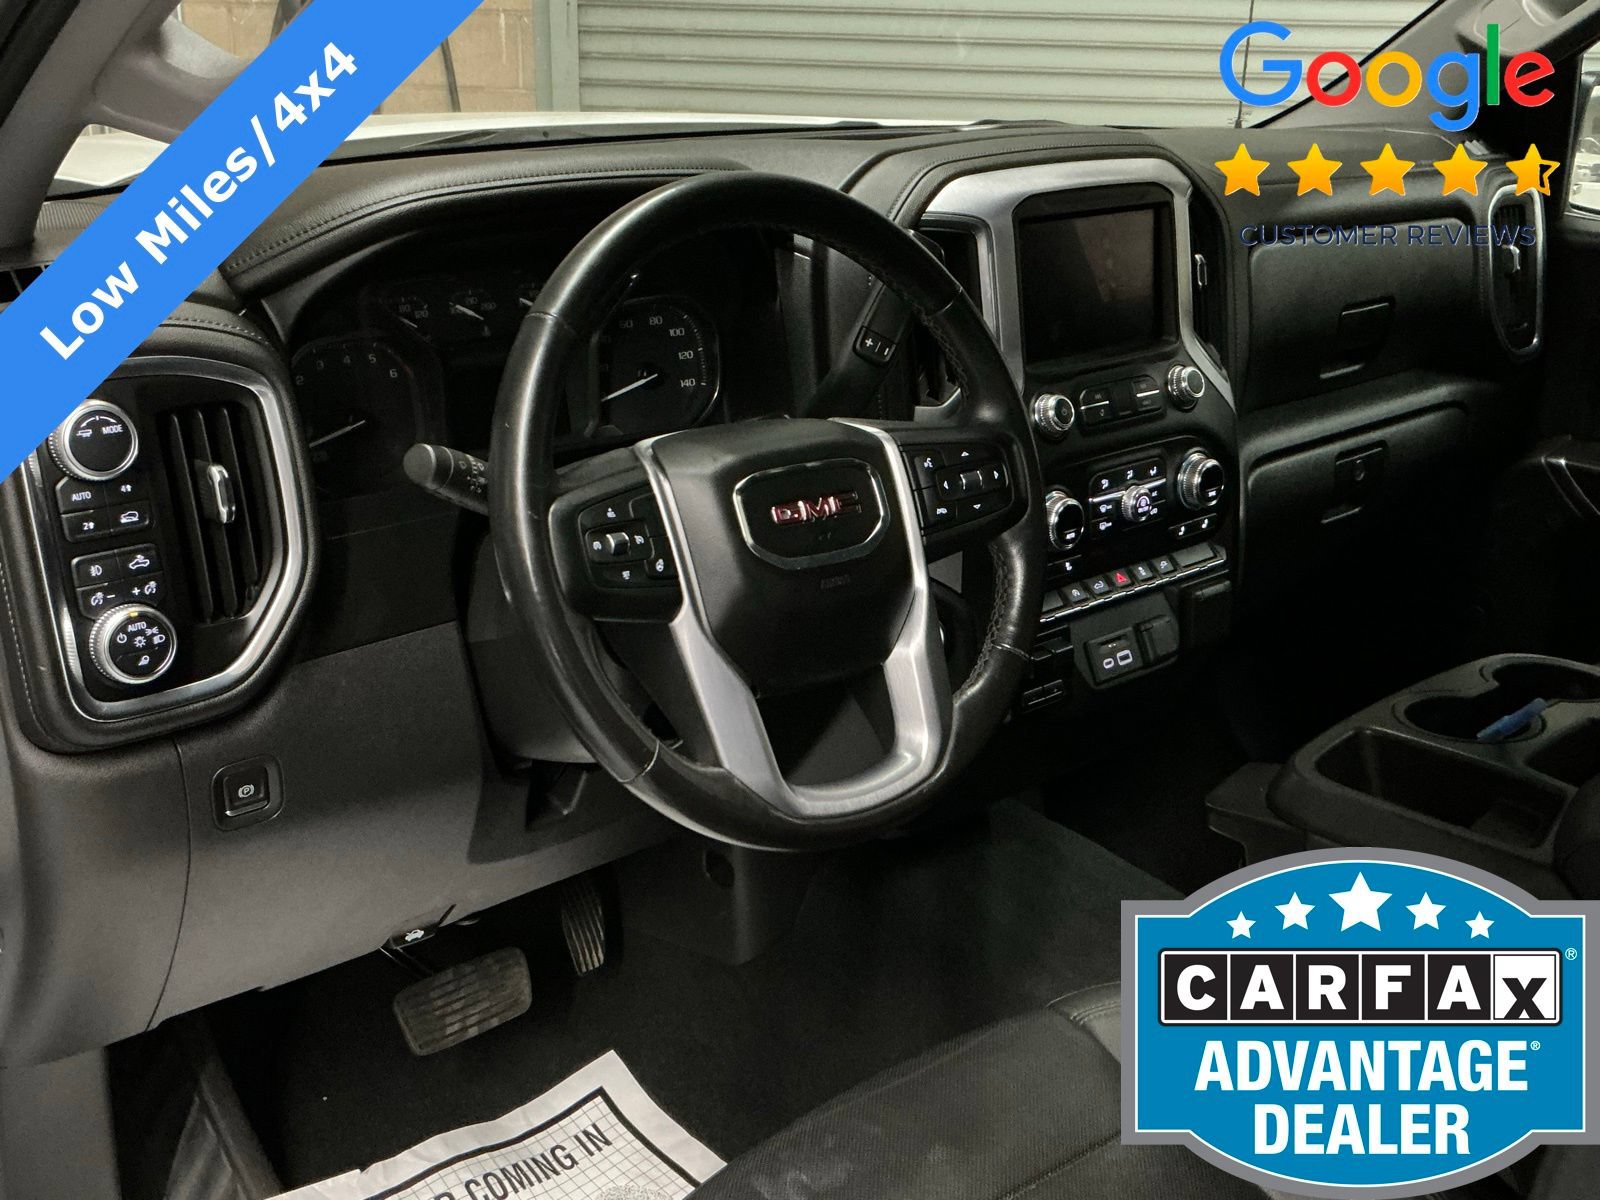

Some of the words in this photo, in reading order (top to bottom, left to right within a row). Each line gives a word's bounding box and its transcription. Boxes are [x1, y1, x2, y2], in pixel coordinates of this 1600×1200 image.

[649, 316, 664, 326] 80
[668, 327, 685, 337] 100
[367, 353, 377, 364] 5
[678, 350, 694, 360] 120
[389, 368, 398, 378] 6
[680, 378, 696, 388] 140
[101, 424, 124, 435] MODE
[71, 490, 92, 502] AUTO
[769, 489, 864, 526] GMC
[127, 621, 147, 633] AUTO
[464, 1144, 579, 1200] COMING
[572, 1122, 613, 1157] IN
